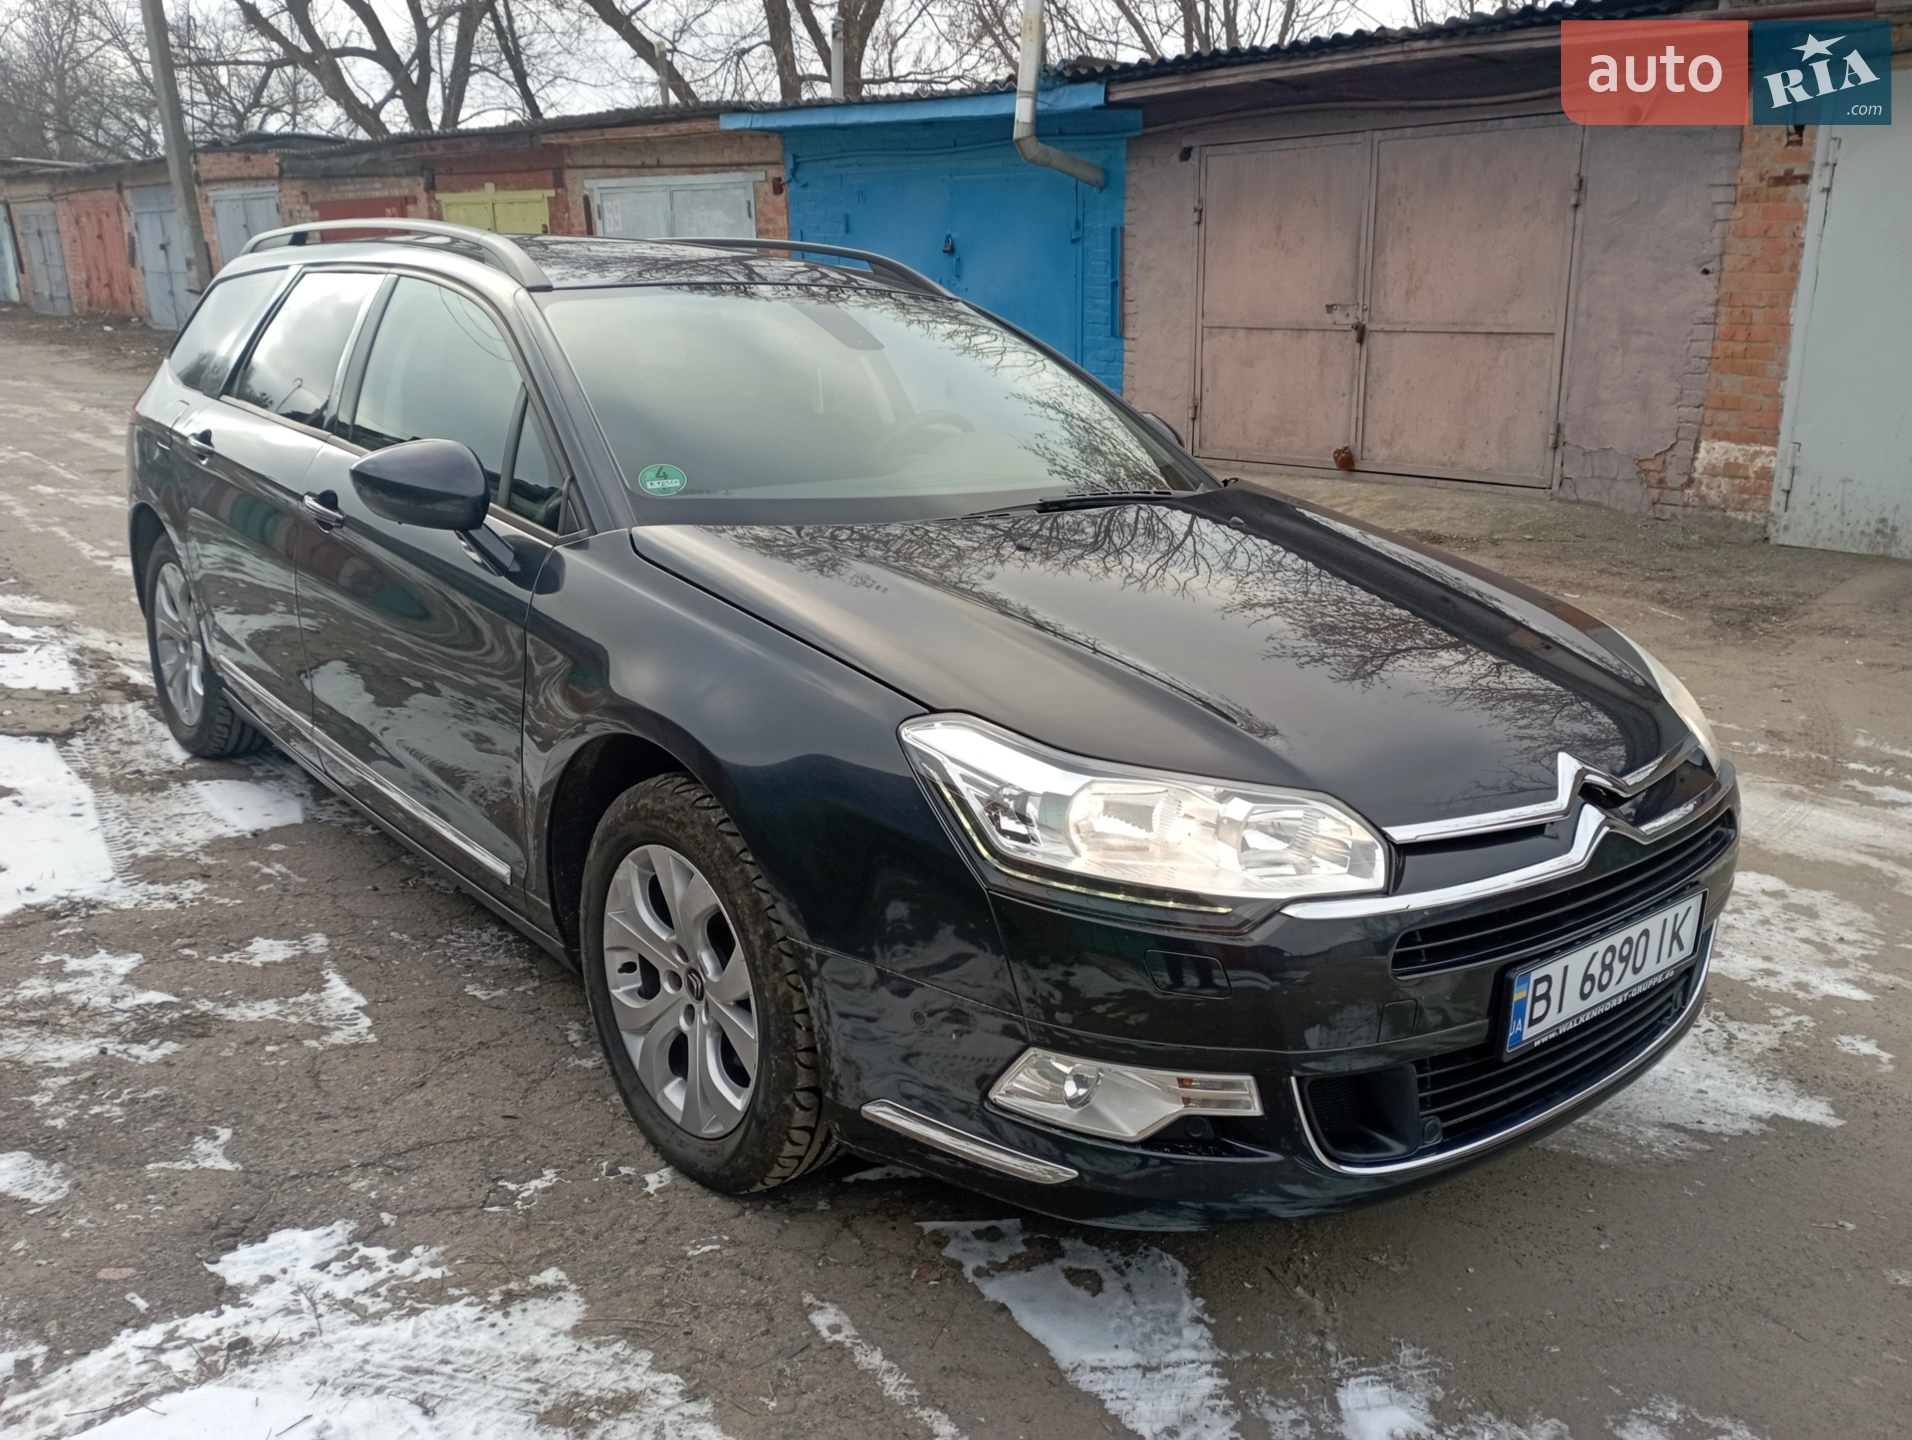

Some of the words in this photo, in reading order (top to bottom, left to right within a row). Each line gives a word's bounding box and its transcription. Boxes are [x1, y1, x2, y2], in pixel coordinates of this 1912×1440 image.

[655, 466, 668, 479] 4
[1527, 964, 1569, 1029] BI
[1579, 928, 1650, 1001] 6890
[1656, 906, 1692, 965] IK
